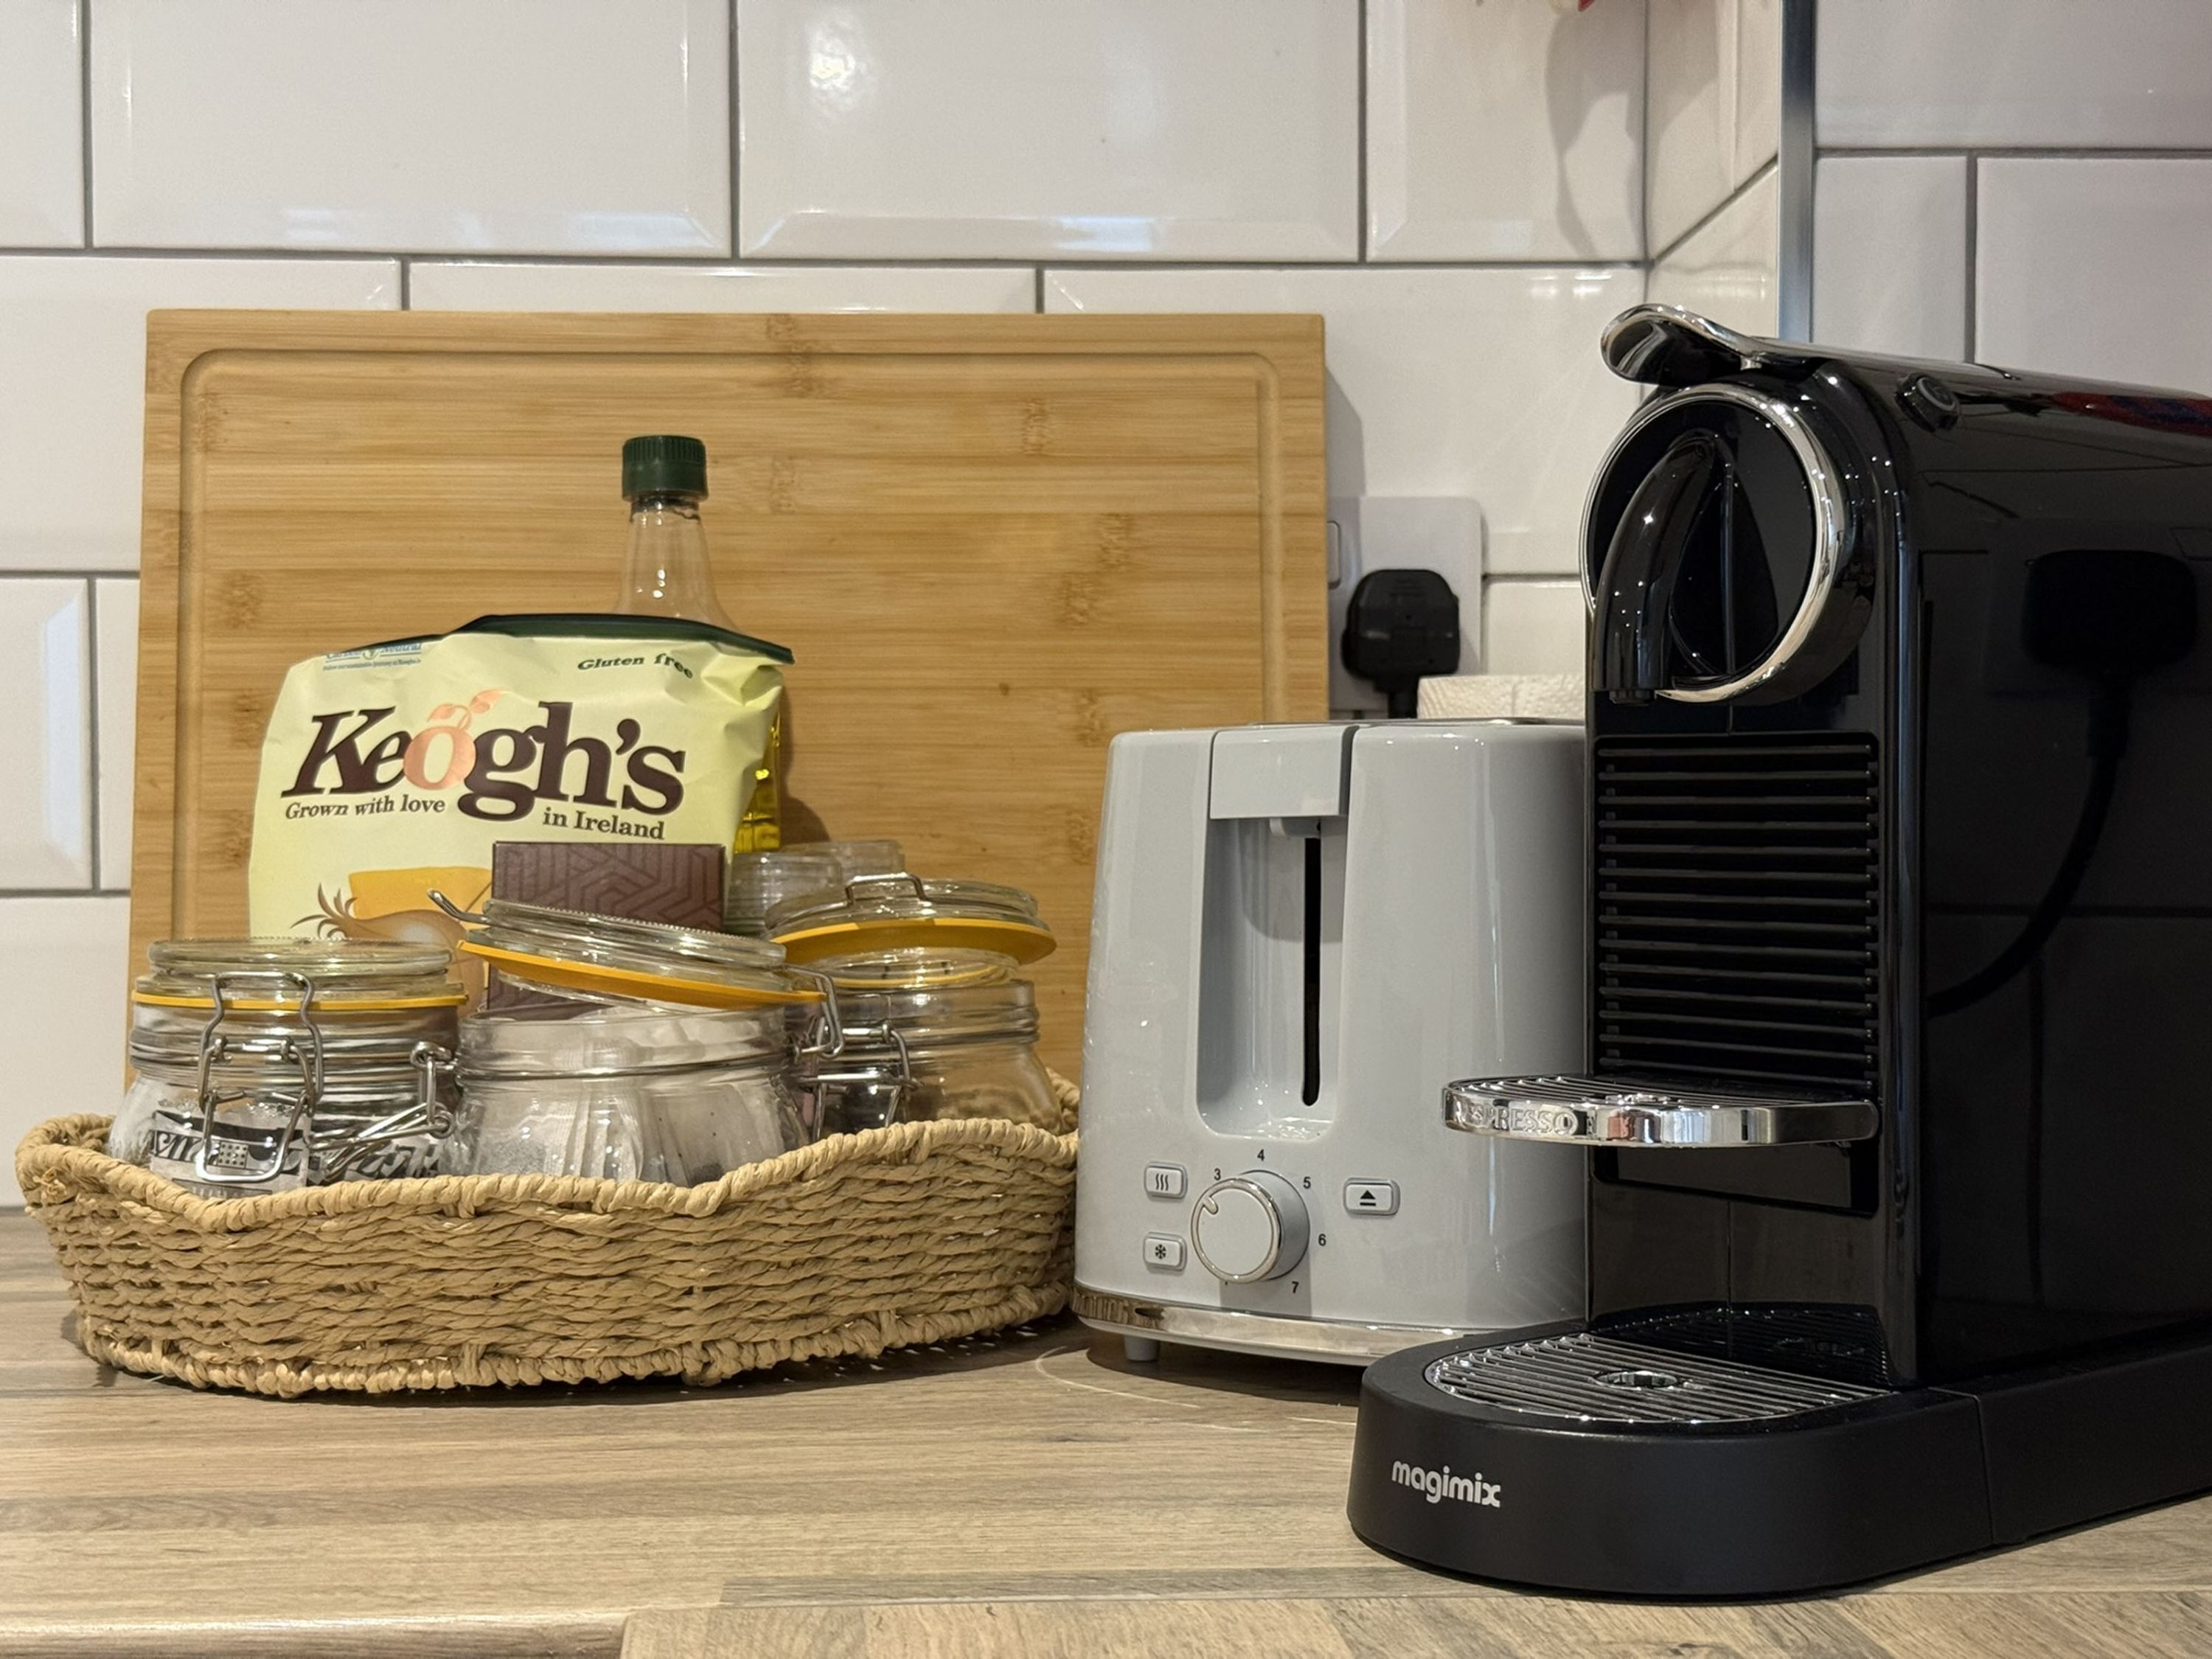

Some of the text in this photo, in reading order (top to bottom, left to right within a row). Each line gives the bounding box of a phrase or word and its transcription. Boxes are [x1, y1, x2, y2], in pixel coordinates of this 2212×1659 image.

[577, 653, 693, 679] Gluten free
[281, 699, 686, 821] Keogh's
[285, 794, 446, 819] Grown with love
[543, 807, 665, 841] in Ireland
[1256, 1149, 1265, 1161] 4
[1214, 1168, 1221, 1181] 3
[1303, 1177, 1311, 1189] 5
[1318, 1234, 1326, 1247] 6
[1291, 1281, 1300, 1294] 7
[1391, 1460, 1501, 1508] magimix
